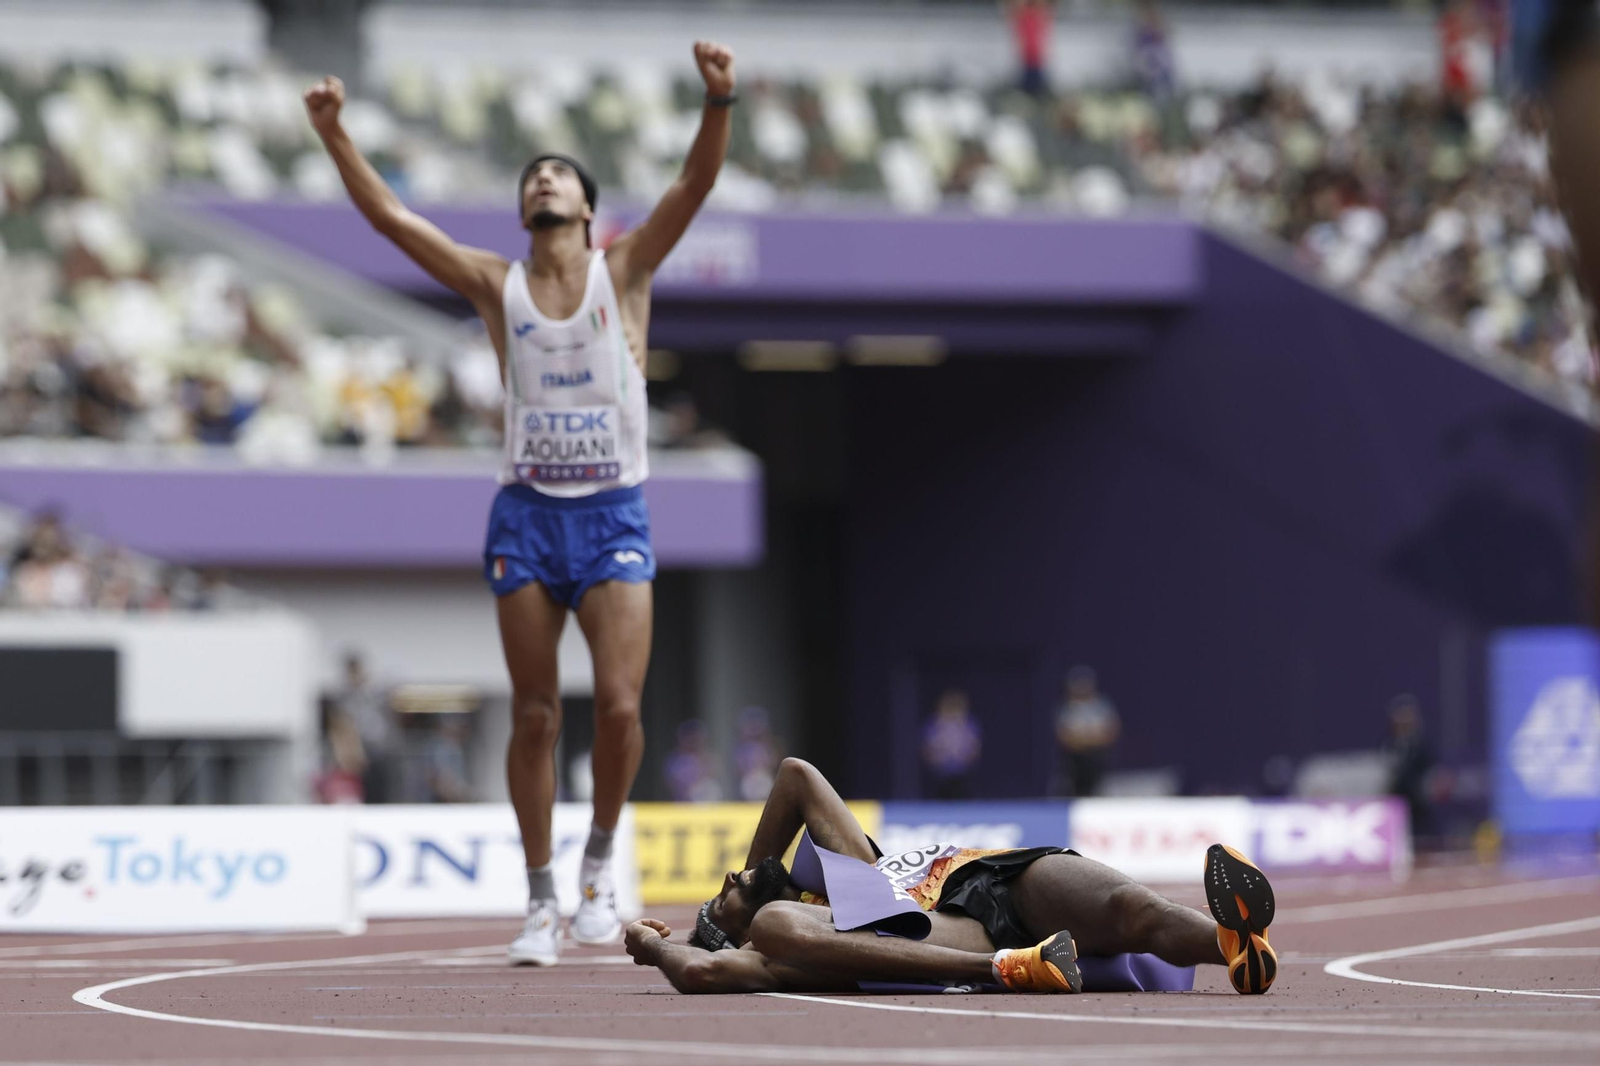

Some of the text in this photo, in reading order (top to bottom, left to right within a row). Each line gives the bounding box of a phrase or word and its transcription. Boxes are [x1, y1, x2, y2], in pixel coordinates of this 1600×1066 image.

[540, 370, 593, 389] ITALIA
[543, 411, 609, 433] TDK
[520, 437, 615, 460] AOUANI
[94, 833, 288, 899] Tokyo
